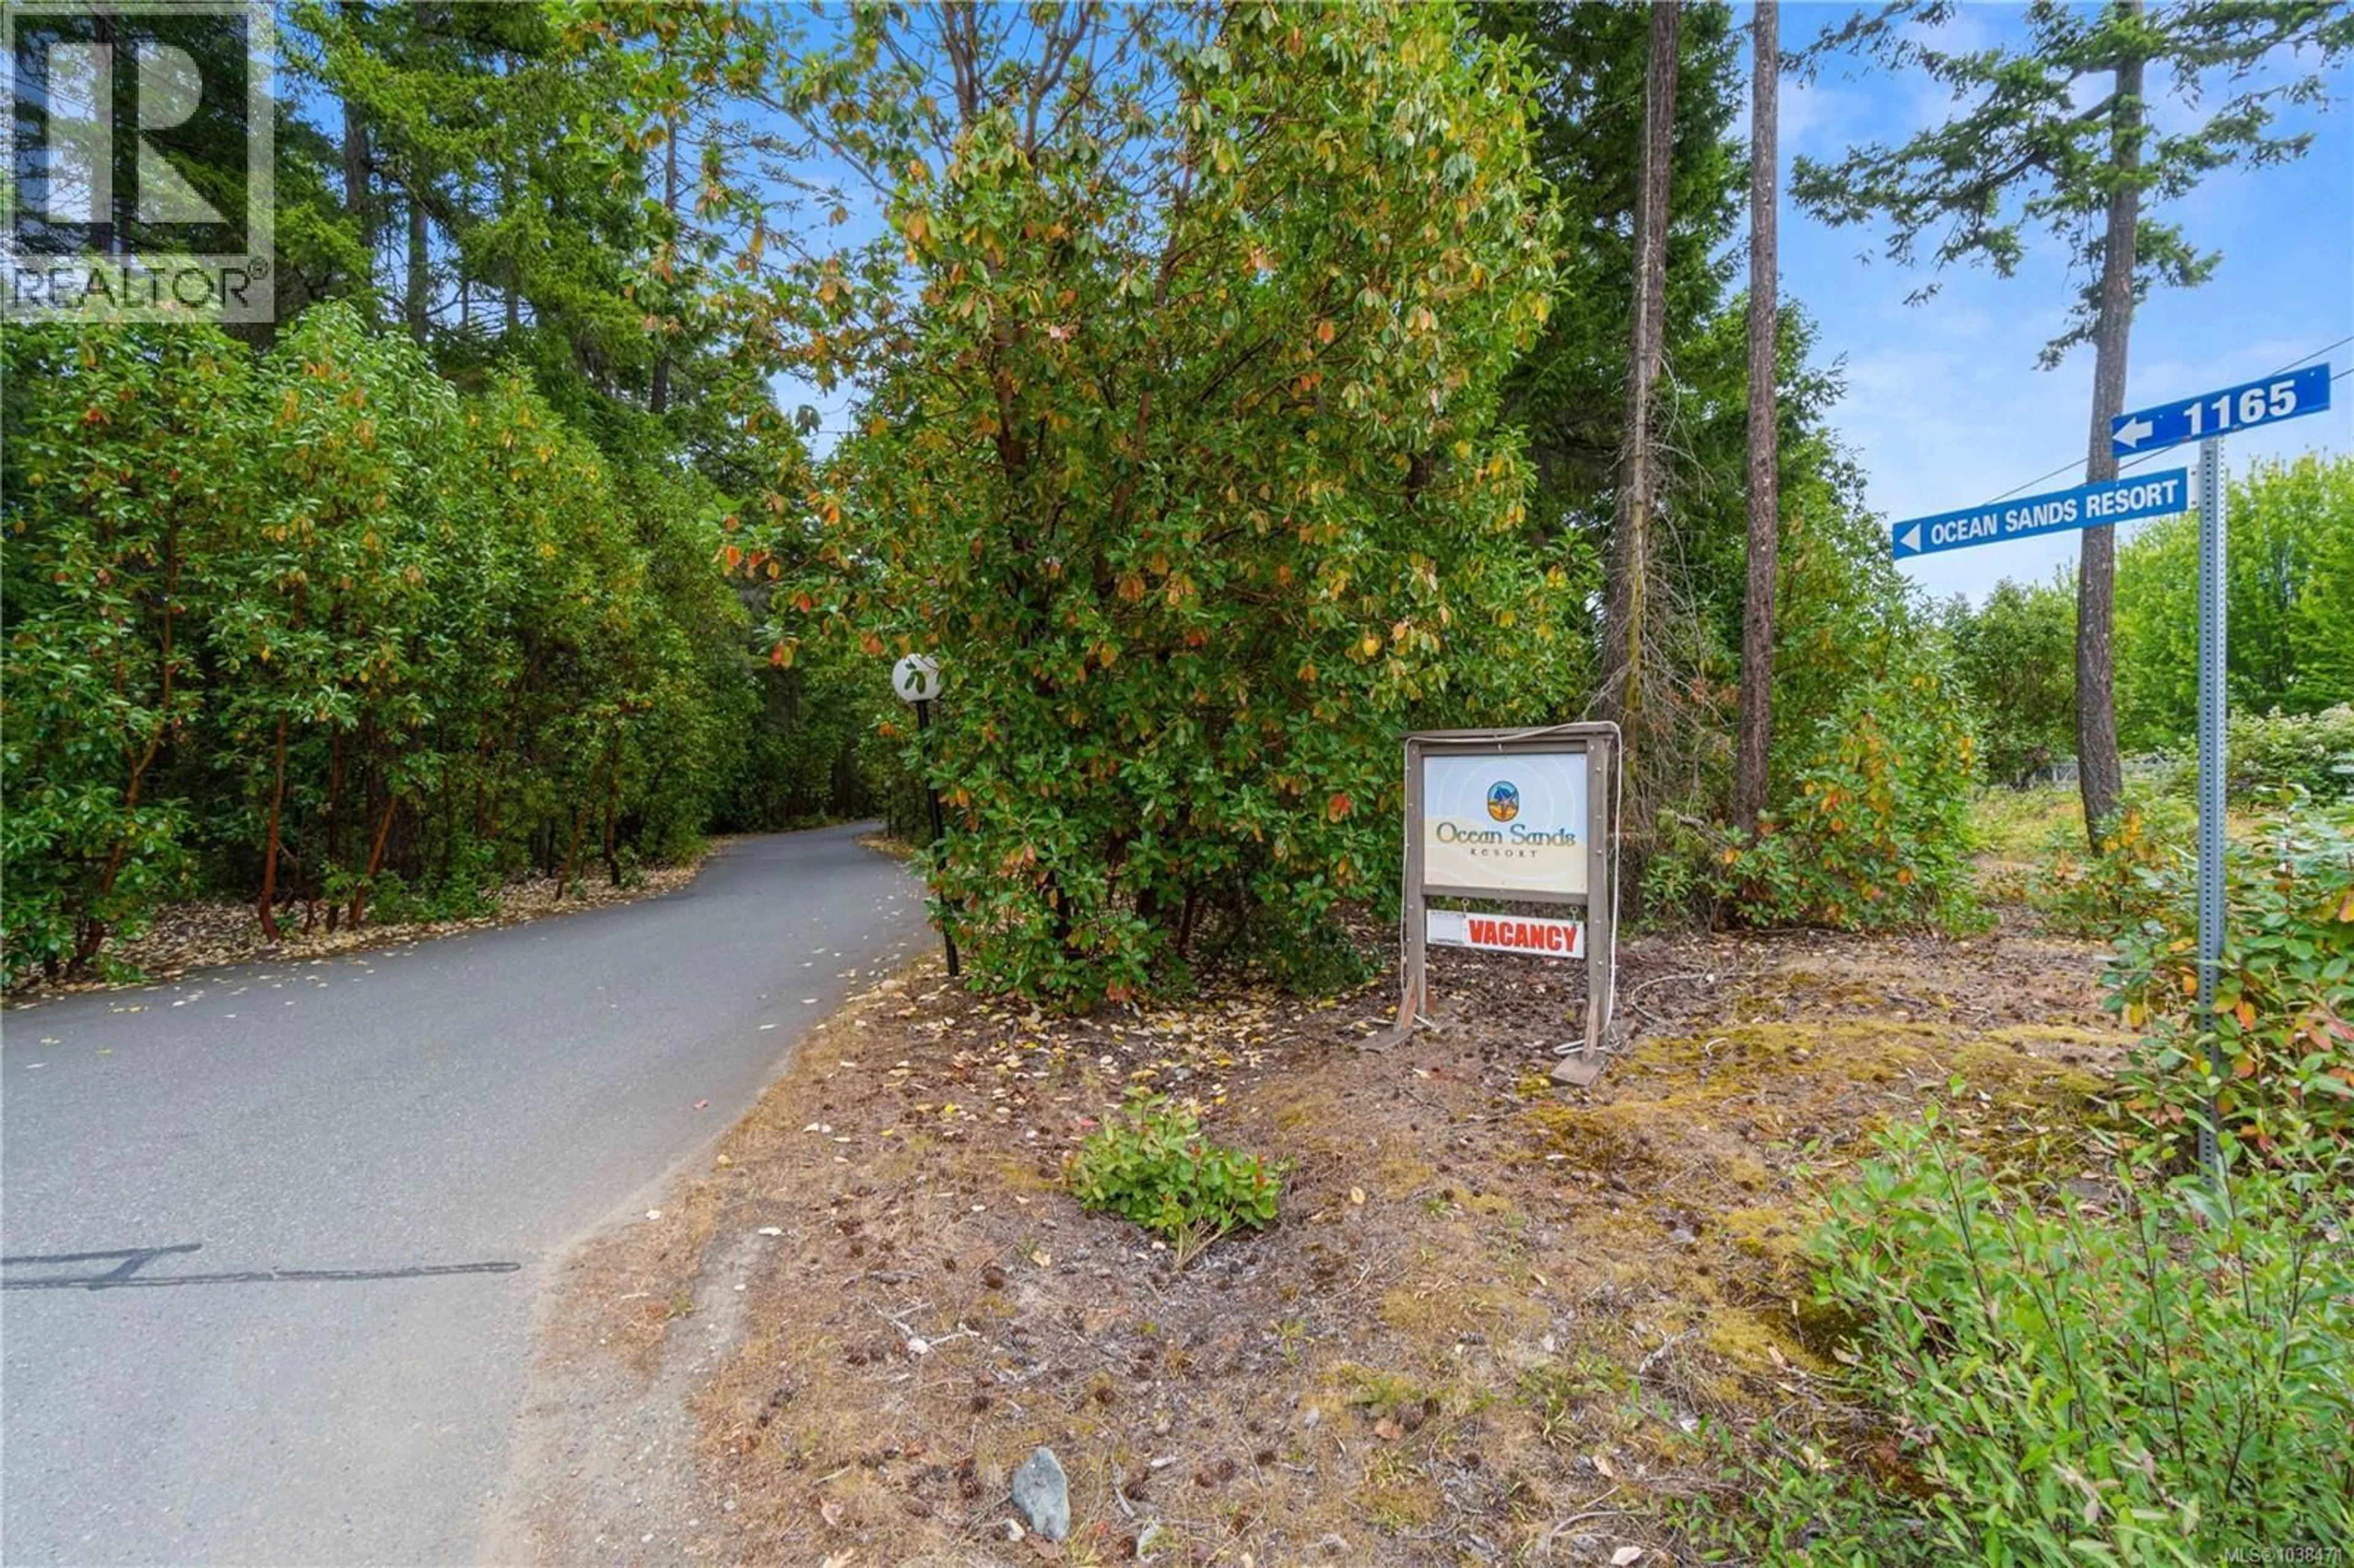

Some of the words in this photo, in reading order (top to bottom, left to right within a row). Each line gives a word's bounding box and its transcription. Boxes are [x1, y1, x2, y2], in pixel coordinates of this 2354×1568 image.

[2184, 379, 2298, 436] 1165
[1930, 513, 1997, 545] OCEAN
[2005, 498, 2078, 532] SANDS
[2086, 479, 2179, 518] RESORT
[1436, 821, 1503, 845] Ocean
[1510, 823, 1576, 847] Sands
[1468, 919, 1578, 953] VACANCY
